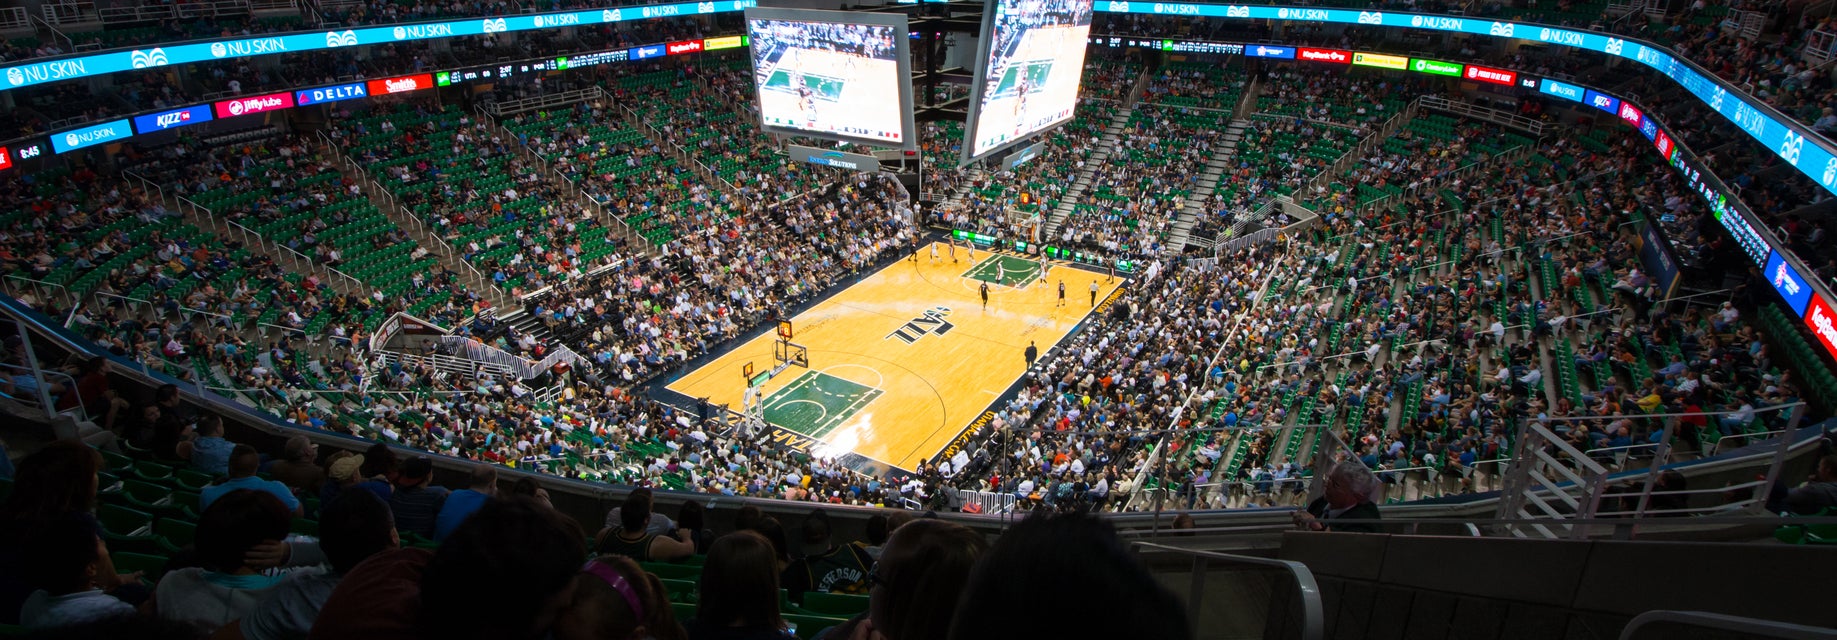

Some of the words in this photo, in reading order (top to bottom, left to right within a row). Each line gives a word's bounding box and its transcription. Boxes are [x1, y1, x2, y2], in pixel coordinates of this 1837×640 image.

[651, 7, 663, 17] NU
[663, 5, 679, 16] SKIN
[1164, 5, 1179, 14] NU
[1180, 6, 1200, 15] SKIN
[1289, 9, 1305, 19] NU
[1306, 9, 1329, 20] SKIN
[545, 15, 558, 27] NU
[560, 13, 579, 26] SKIN
[1423, 17, 1439, 29] NU
[1440, 18, 1463, 30] SKIN
[407, 26, 425, 38] NU
[427, 23, 451, 37] SKIN
[1550, 30, 1564, 43] NU
[1564, 31, 1585, 46] SKIN
[228, 42, 251, 56] NU
[252, 38, 286, 53] SKIN
[24, 65, 49, 83] NU
[50, 59, 87, 79] SKIN
[464, 72, 477, 80] UTA
[313, 85, 364, 101] DELTA
[157, 112, 181, 128] KJZZ
[79, 132, 93, 144] NU
[94, 127, 114, 140] SKIN
[20, 145, 41, 159] 8:45
[1811, 304, 1837, 350] KeyBan
